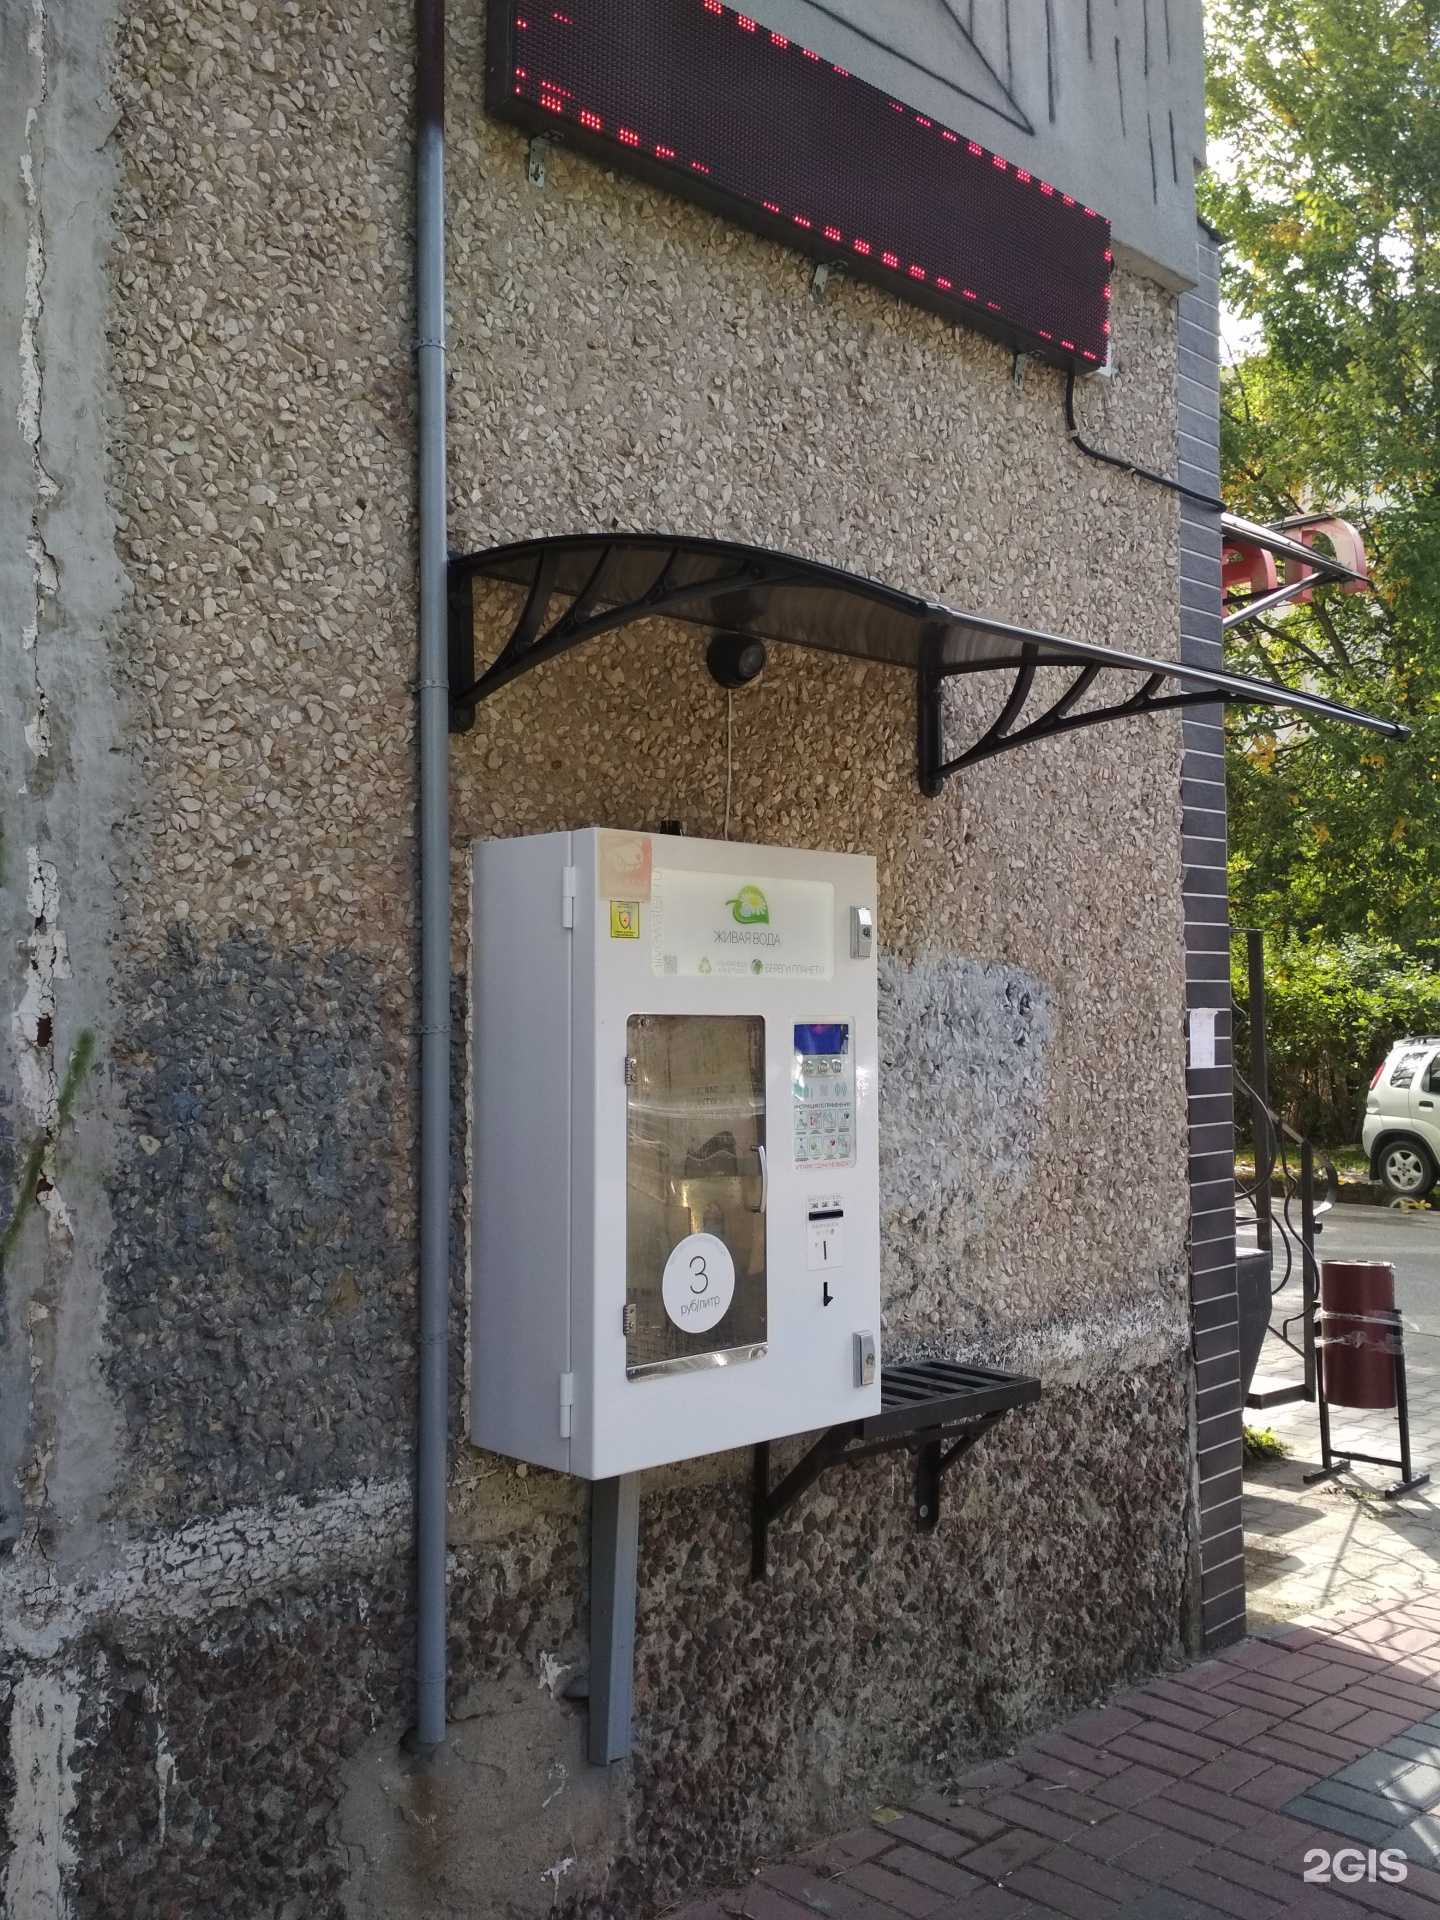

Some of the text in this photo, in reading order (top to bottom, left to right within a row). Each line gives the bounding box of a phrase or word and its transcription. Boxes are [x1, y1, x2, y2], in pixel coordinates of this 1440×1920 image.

[713, 930, 781, 946] ЖИВАЯ ВОДА
[689, 1255, 709, 1294] 3
[680, 1295, 721, 1317] руб/литр
